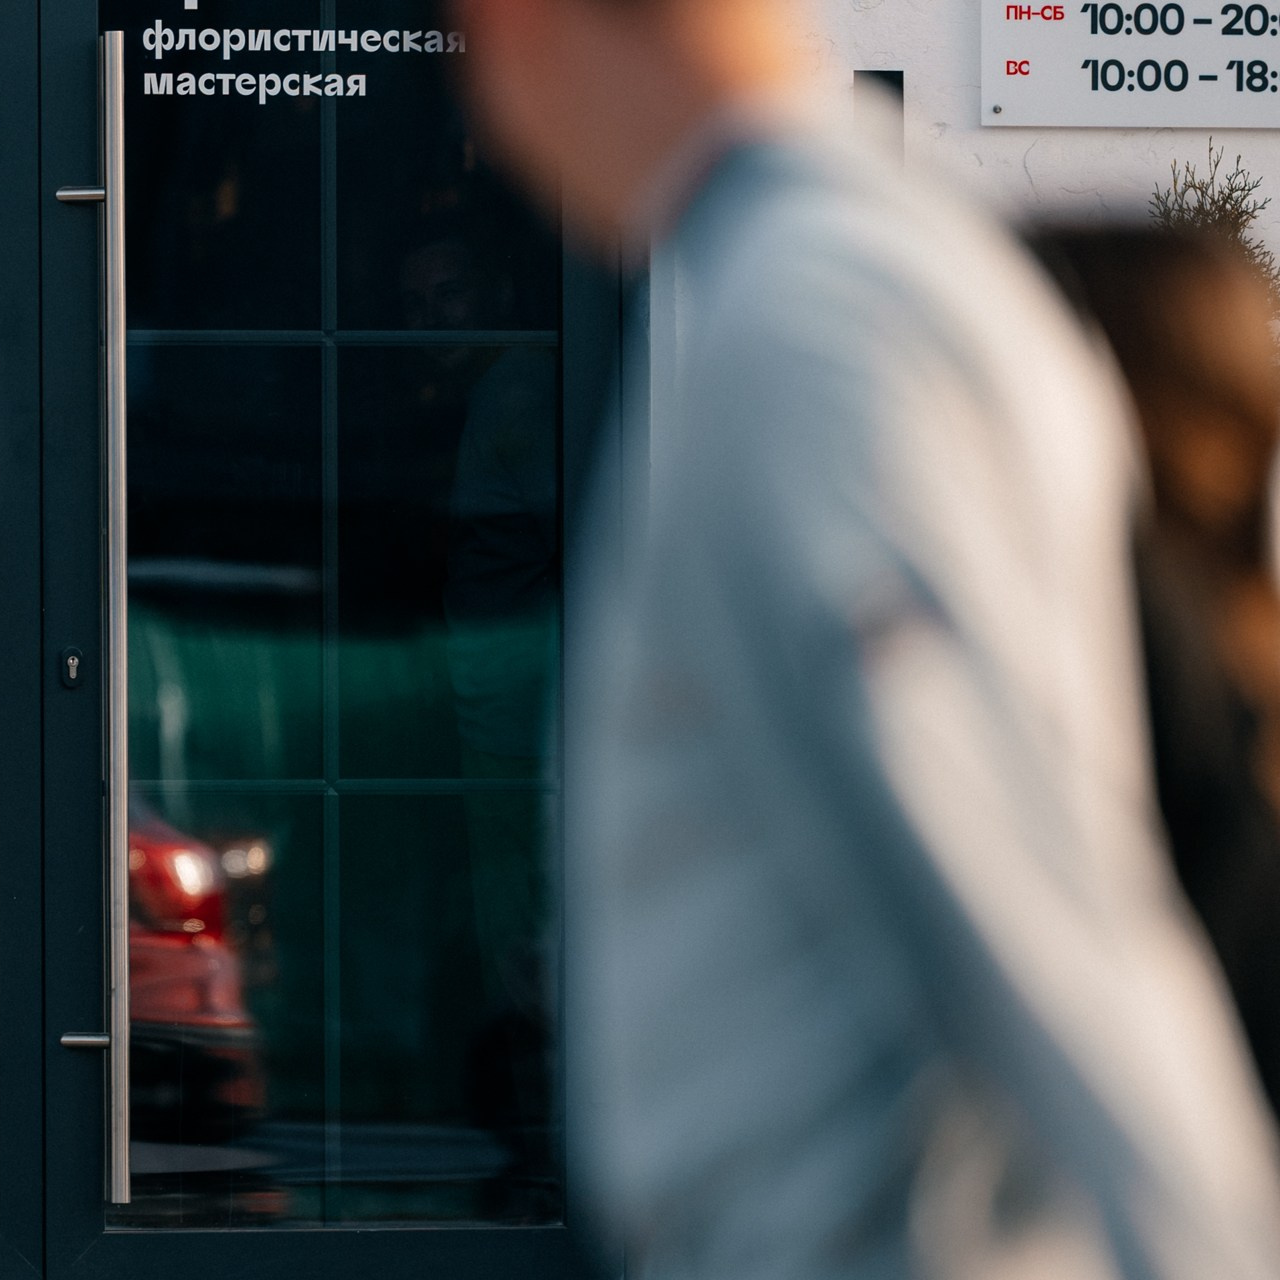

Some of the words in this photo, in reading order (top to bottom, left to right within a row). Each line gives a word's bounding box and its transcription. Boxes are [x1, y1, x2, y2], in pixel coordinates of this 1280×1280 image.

[1080, 3, 1185, 35] 10:00
[142, 19, 466, 61] флористическая
[1006, 61, 1030, 75] ВС
[1081, 59, 1189, 92] 10:00
[143, 71, 367, 105] мастерская
